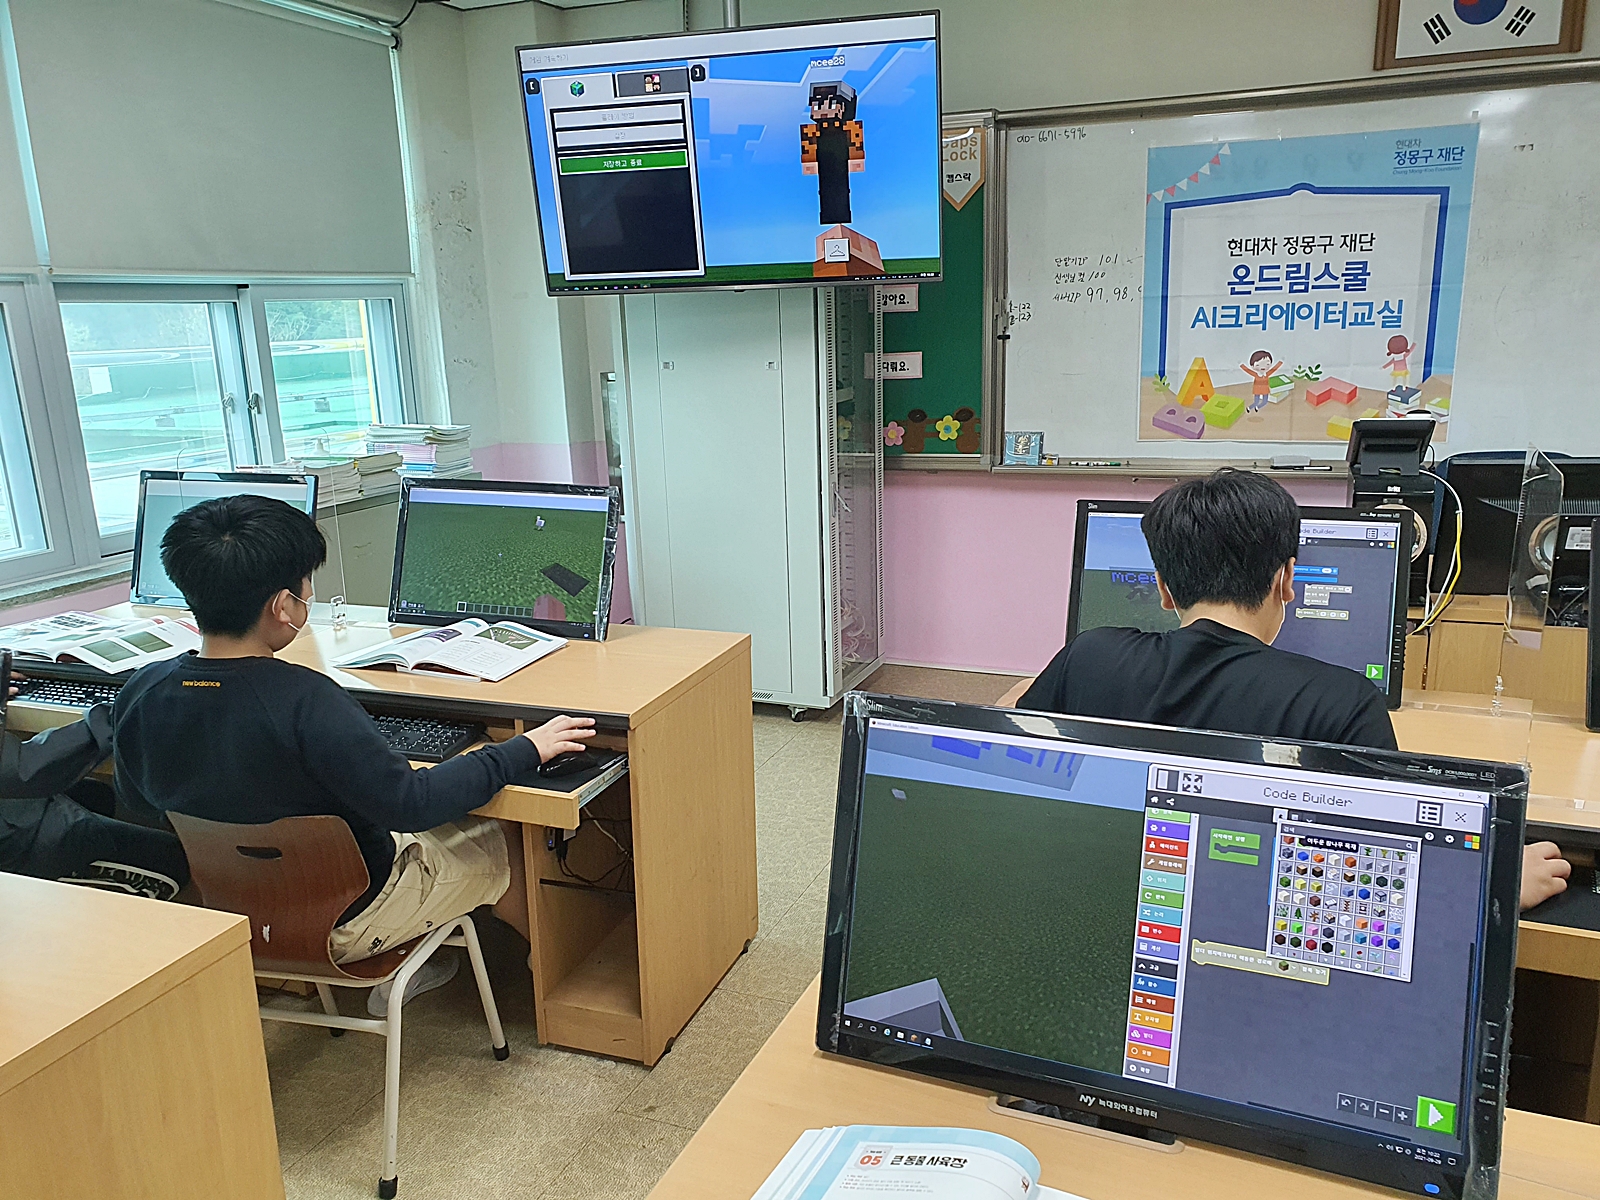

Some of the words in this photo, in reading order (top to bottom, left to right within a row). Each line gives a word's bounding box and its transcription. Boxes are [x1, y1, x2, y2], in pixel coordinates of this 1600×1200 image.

[810, 56, 845, 67] mcee28
[1396, 138, 1422, 150] 현대차
[1394, 149, 1434, 166] 정몽구
[1436, 146, 1466, 163] 재단
[602, 160, 628, 168] 저장하고
[630, 158, 642, 166] 종료
[1227, 236, 1278, 257] 현대차
[1282, 234, 1334, 256] 정몽구
[1339, 232, 1376, 253] 재단
[1098, 253, 1118, 266] 101
[1088, 270, 1106, 282] 100
[1226, 260, 1371, 296] 온드림스쿨
[1190, 299, 1404, 331] AI크리에이터교실
[866, 700, 883, 712] Slim
[1262, 786, 1298, 801] Code
[1302, 791, 1353, 808] Builder
[1306, 838, 1324, 846] 어두운
[1098, 1098, 1158, 1119] 늑대와여우컴퓨터
[860, 1155, 882, 1166] 05
[926, 1155, 968, 1168] 사육장
